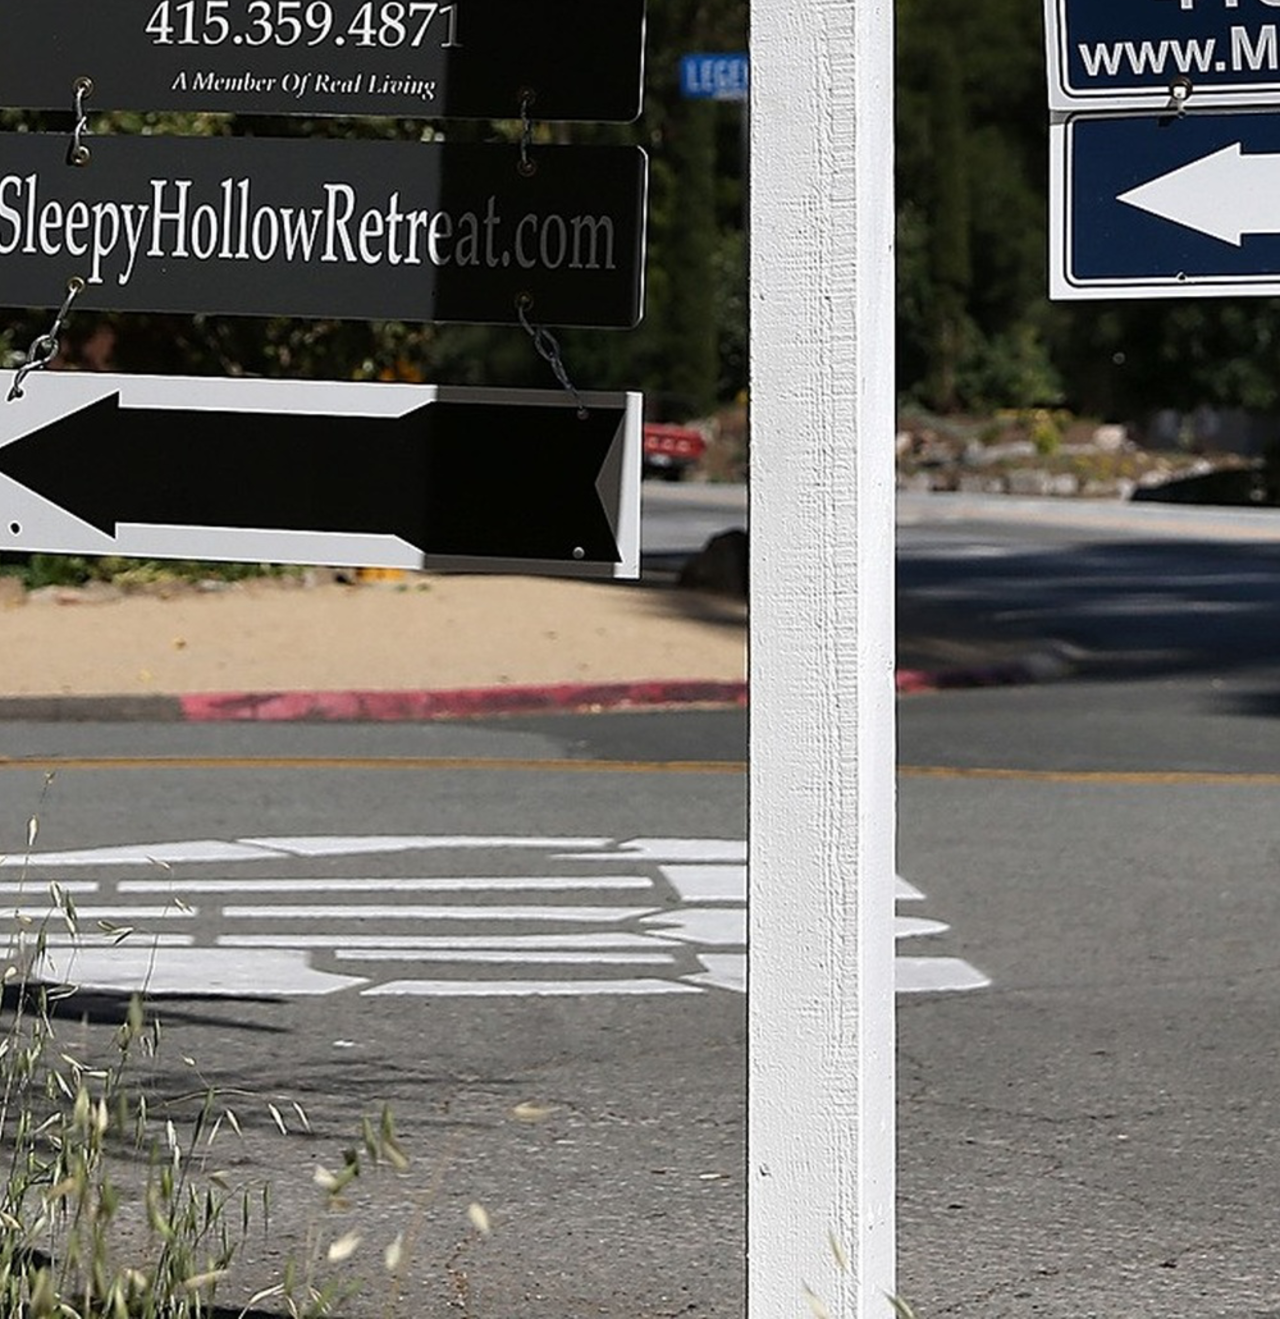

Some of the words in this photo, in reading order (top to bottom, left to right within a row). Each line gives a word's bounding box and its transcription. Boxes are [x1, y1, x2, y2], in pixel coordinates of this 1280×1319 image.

[145, 0, 463, 49] 415.359.4871
[172, 73, 188, 91] A
[192, 73, 276, 94] Member
[280, 73, 312, 99] Of
[314, 73, 362, 96] Real
[368, 73, 437, 101] Living
